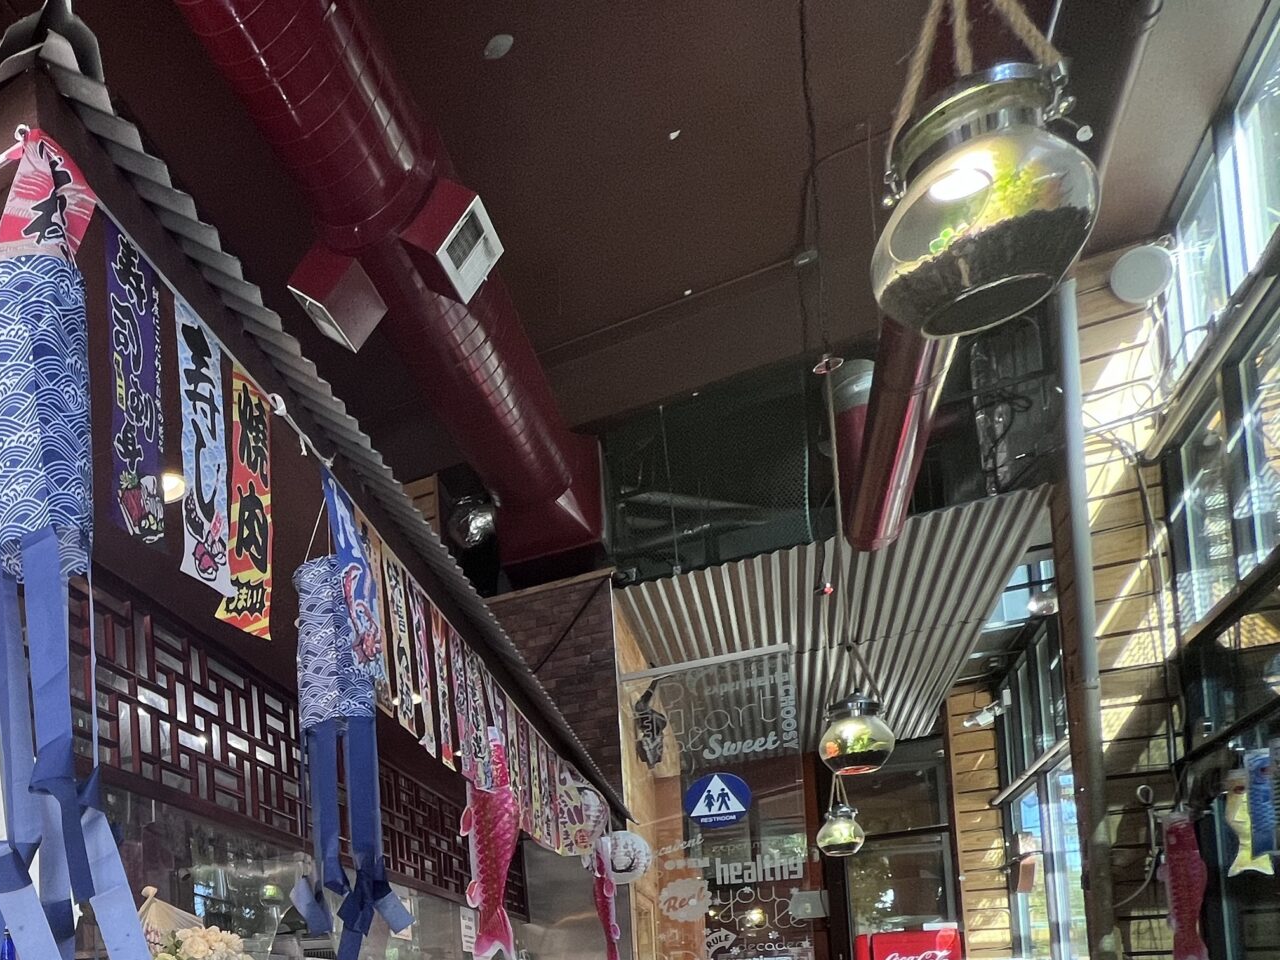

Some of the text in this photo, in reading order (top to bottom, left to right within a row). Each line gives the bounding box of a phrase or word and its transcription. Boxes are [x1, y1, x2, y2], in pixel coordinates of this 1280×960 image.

[236, 383, 270, 574] 焼肉
[780, 685, 799, 749] CHOOSY
[703, 730, 780, 760] Sweet
[700, 814, 737, 824] RESTROOM
[715, 854, 804, 885] healthy
[706, 933, 731, 949] RULE
